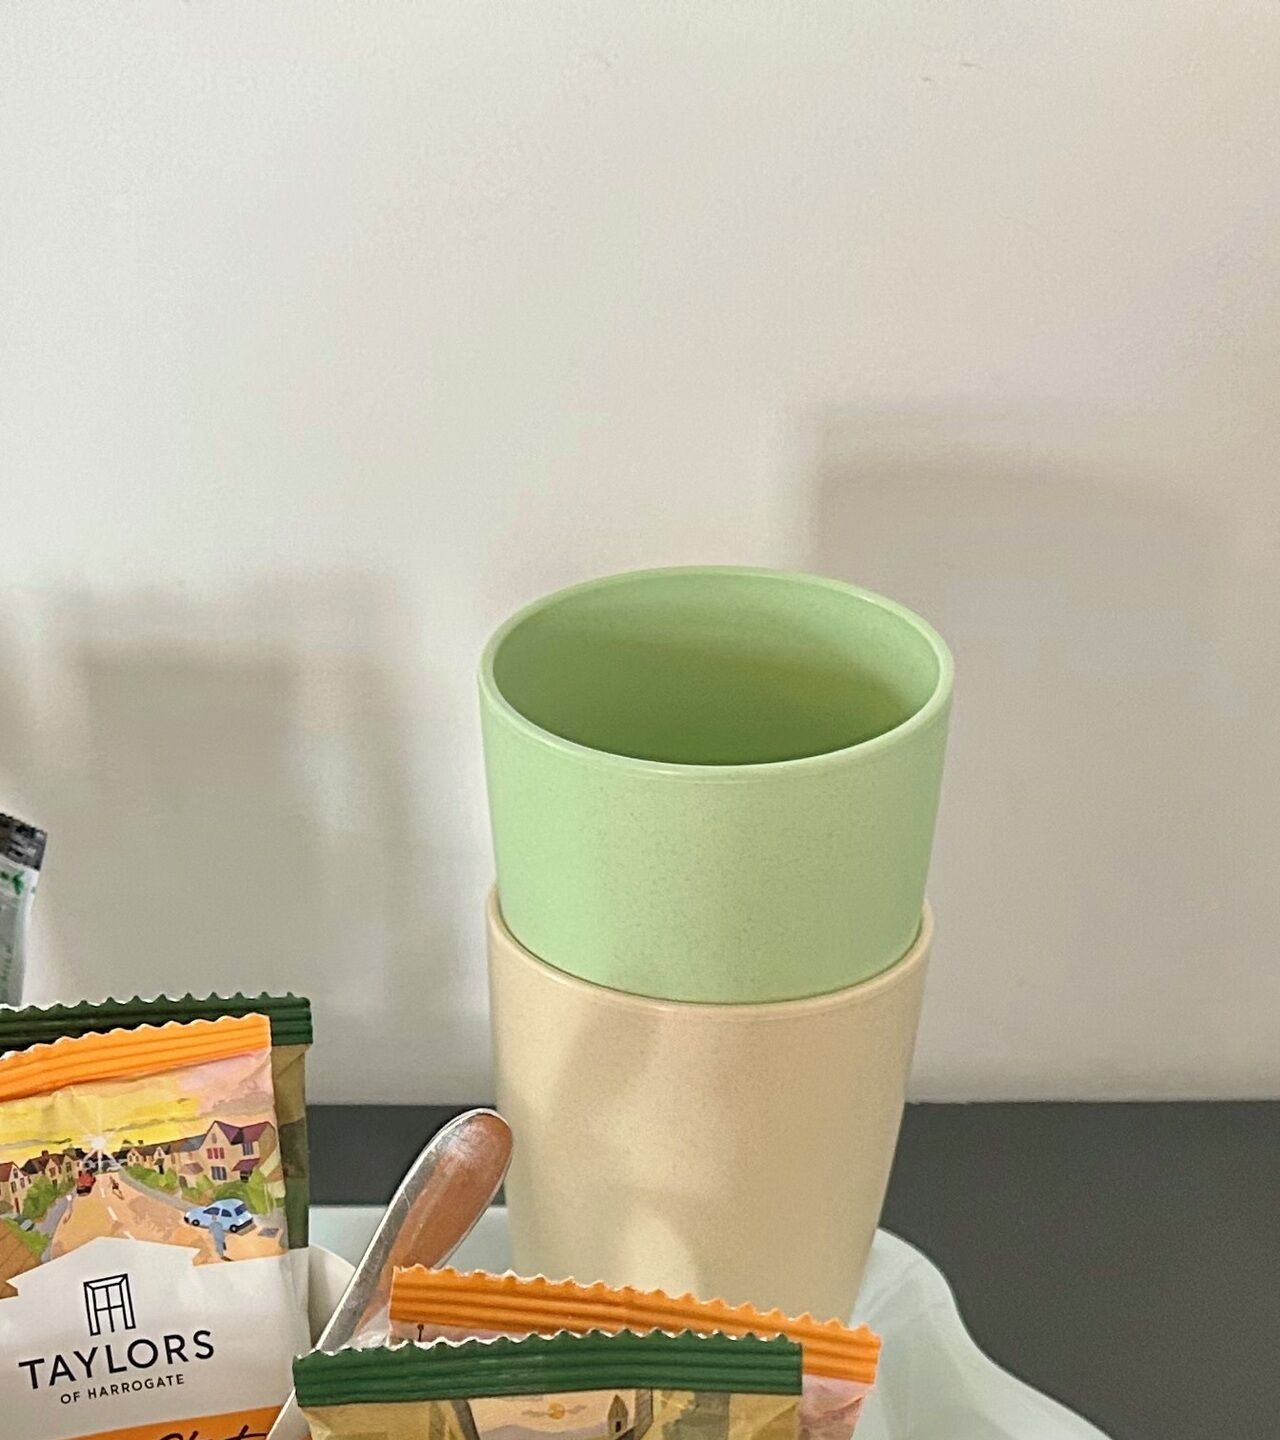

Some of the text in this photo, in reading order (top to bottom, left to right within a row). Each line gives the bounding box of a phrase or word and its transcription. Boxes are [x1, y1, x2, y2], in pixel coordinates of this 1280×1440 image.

[19, 1330, 214, 1390] TAYLORS
[60, 1373, 185, 1405] OF HARROGATE
